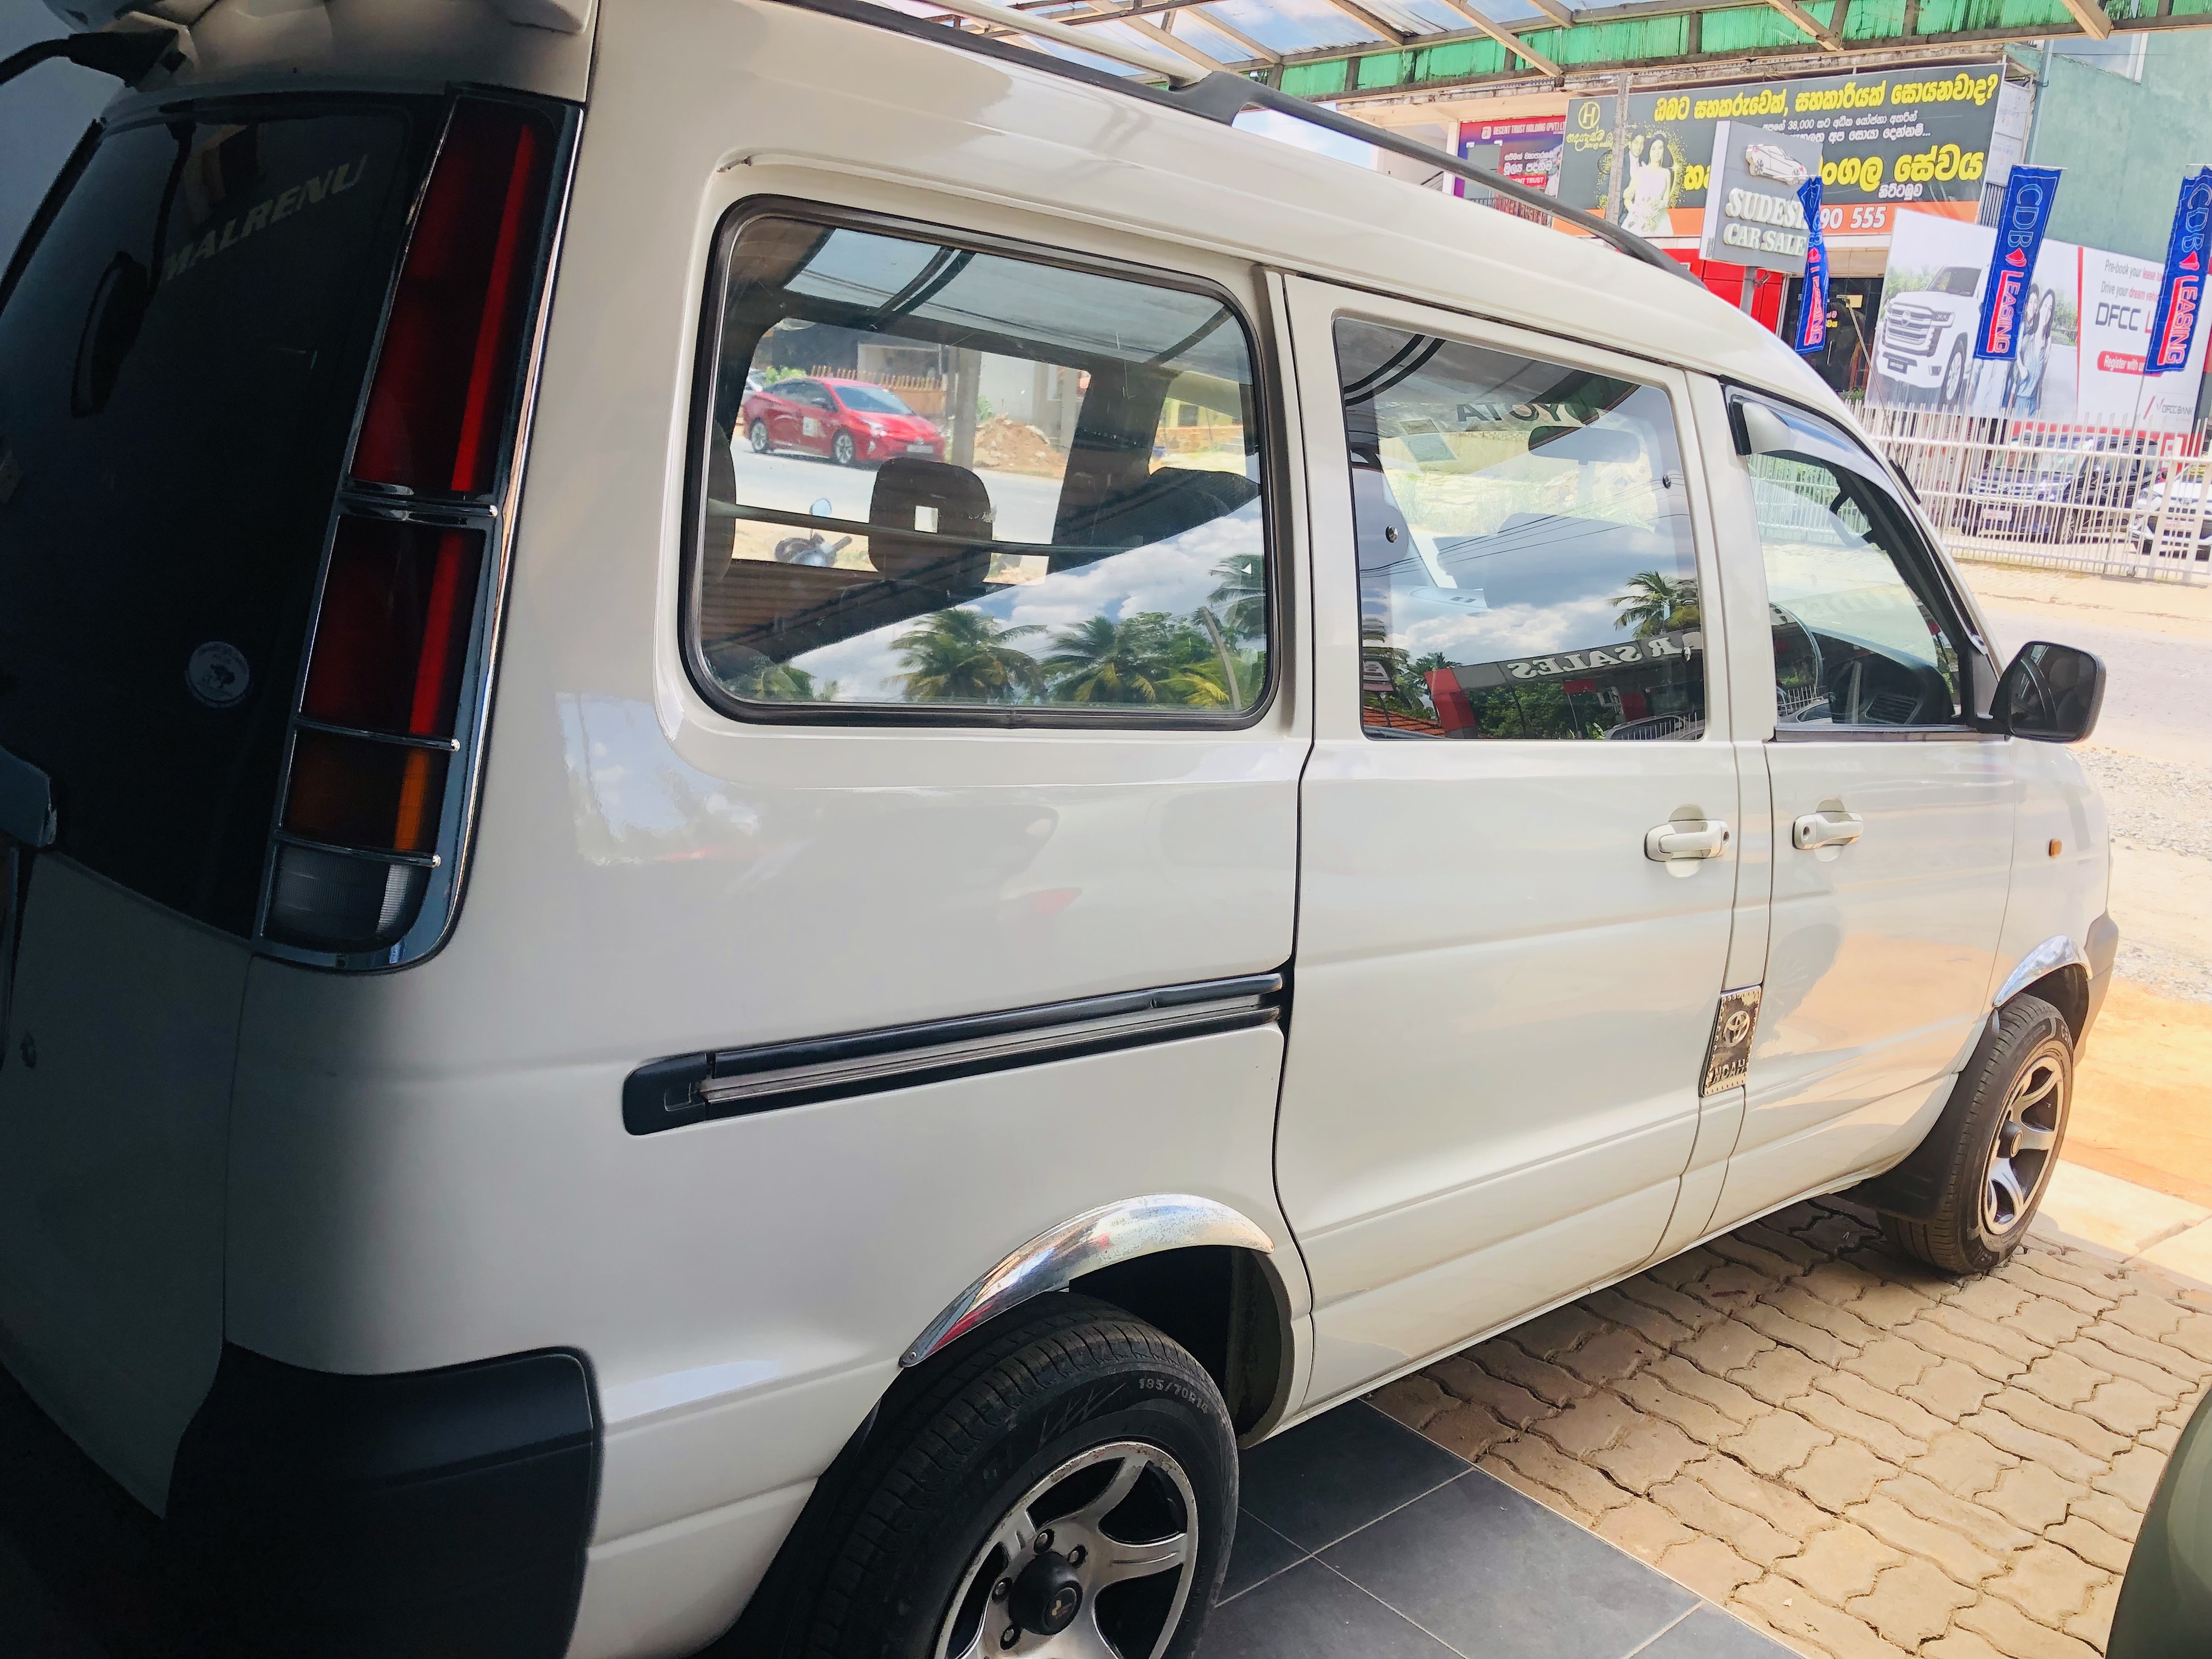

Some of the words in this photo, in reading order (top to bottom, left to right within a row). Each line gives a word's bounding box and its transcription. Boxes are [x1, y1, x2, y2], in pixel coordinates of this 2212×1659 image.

[1654, 95, 1690, 122] ඔබට
[1493, 125, 1510, 136] DECENT
[1511, 124, 1526, 134] TRUST
[1526, 122, 1545, 133] HOLDING
[1787, 119, 1814, 132] 38,000
[1819, 155, 1884, 193] ංගල
[1894, 143, 1985, 183] සේවය
[1849, 206, 1888, 229] 555
[2007, 183, 2043, 248] CDB
[2181, 183, 2212, 253] CDB
[1723, 223, 1762, 250] CAR
[2104, 259, 2129, 274] Pre-book
[2129, 264, 2142, 279] your
[2142, 267, 2156, 280] lease
[2101, 280, 2115, 295] Drive
[2115, 285, 2129, 298] your
[2129, 287, 2146, 299] dream
[1986, 270, 2024, 354] LEASING
[2095, 301, 2141, 331] DFCC
[2157, 275, 2199, 366] LEASING
[2104, 355, 2126, 371] Register
[2127, 358, 2139, 370] with
[2177, 405, 2194, 415] BANK
